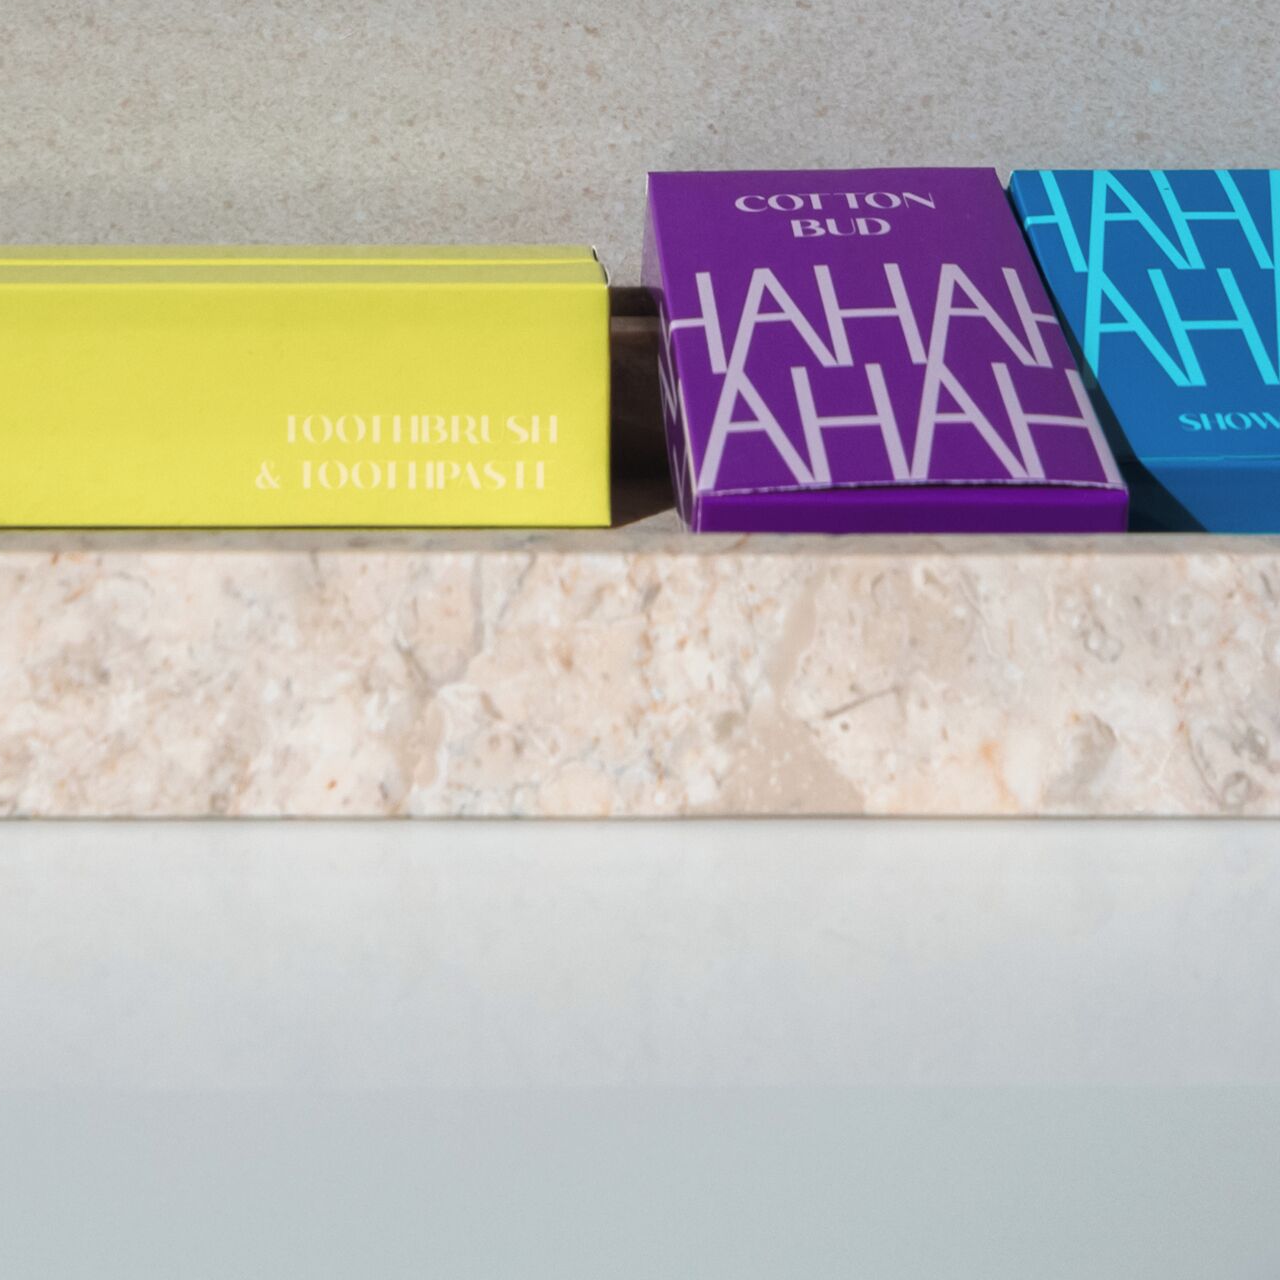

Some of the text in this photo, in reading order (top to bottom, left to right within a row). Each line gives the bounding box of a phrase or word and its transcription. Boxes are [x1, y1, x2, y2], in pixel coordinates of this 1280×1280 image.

[734, 191, 937, 214] COTTON
[791, 217, 892, 238] BUD
[283, 414, 558, 445] TOOTHBRUSH
[254, 460, 552, 490] & TOOTHPASTE
